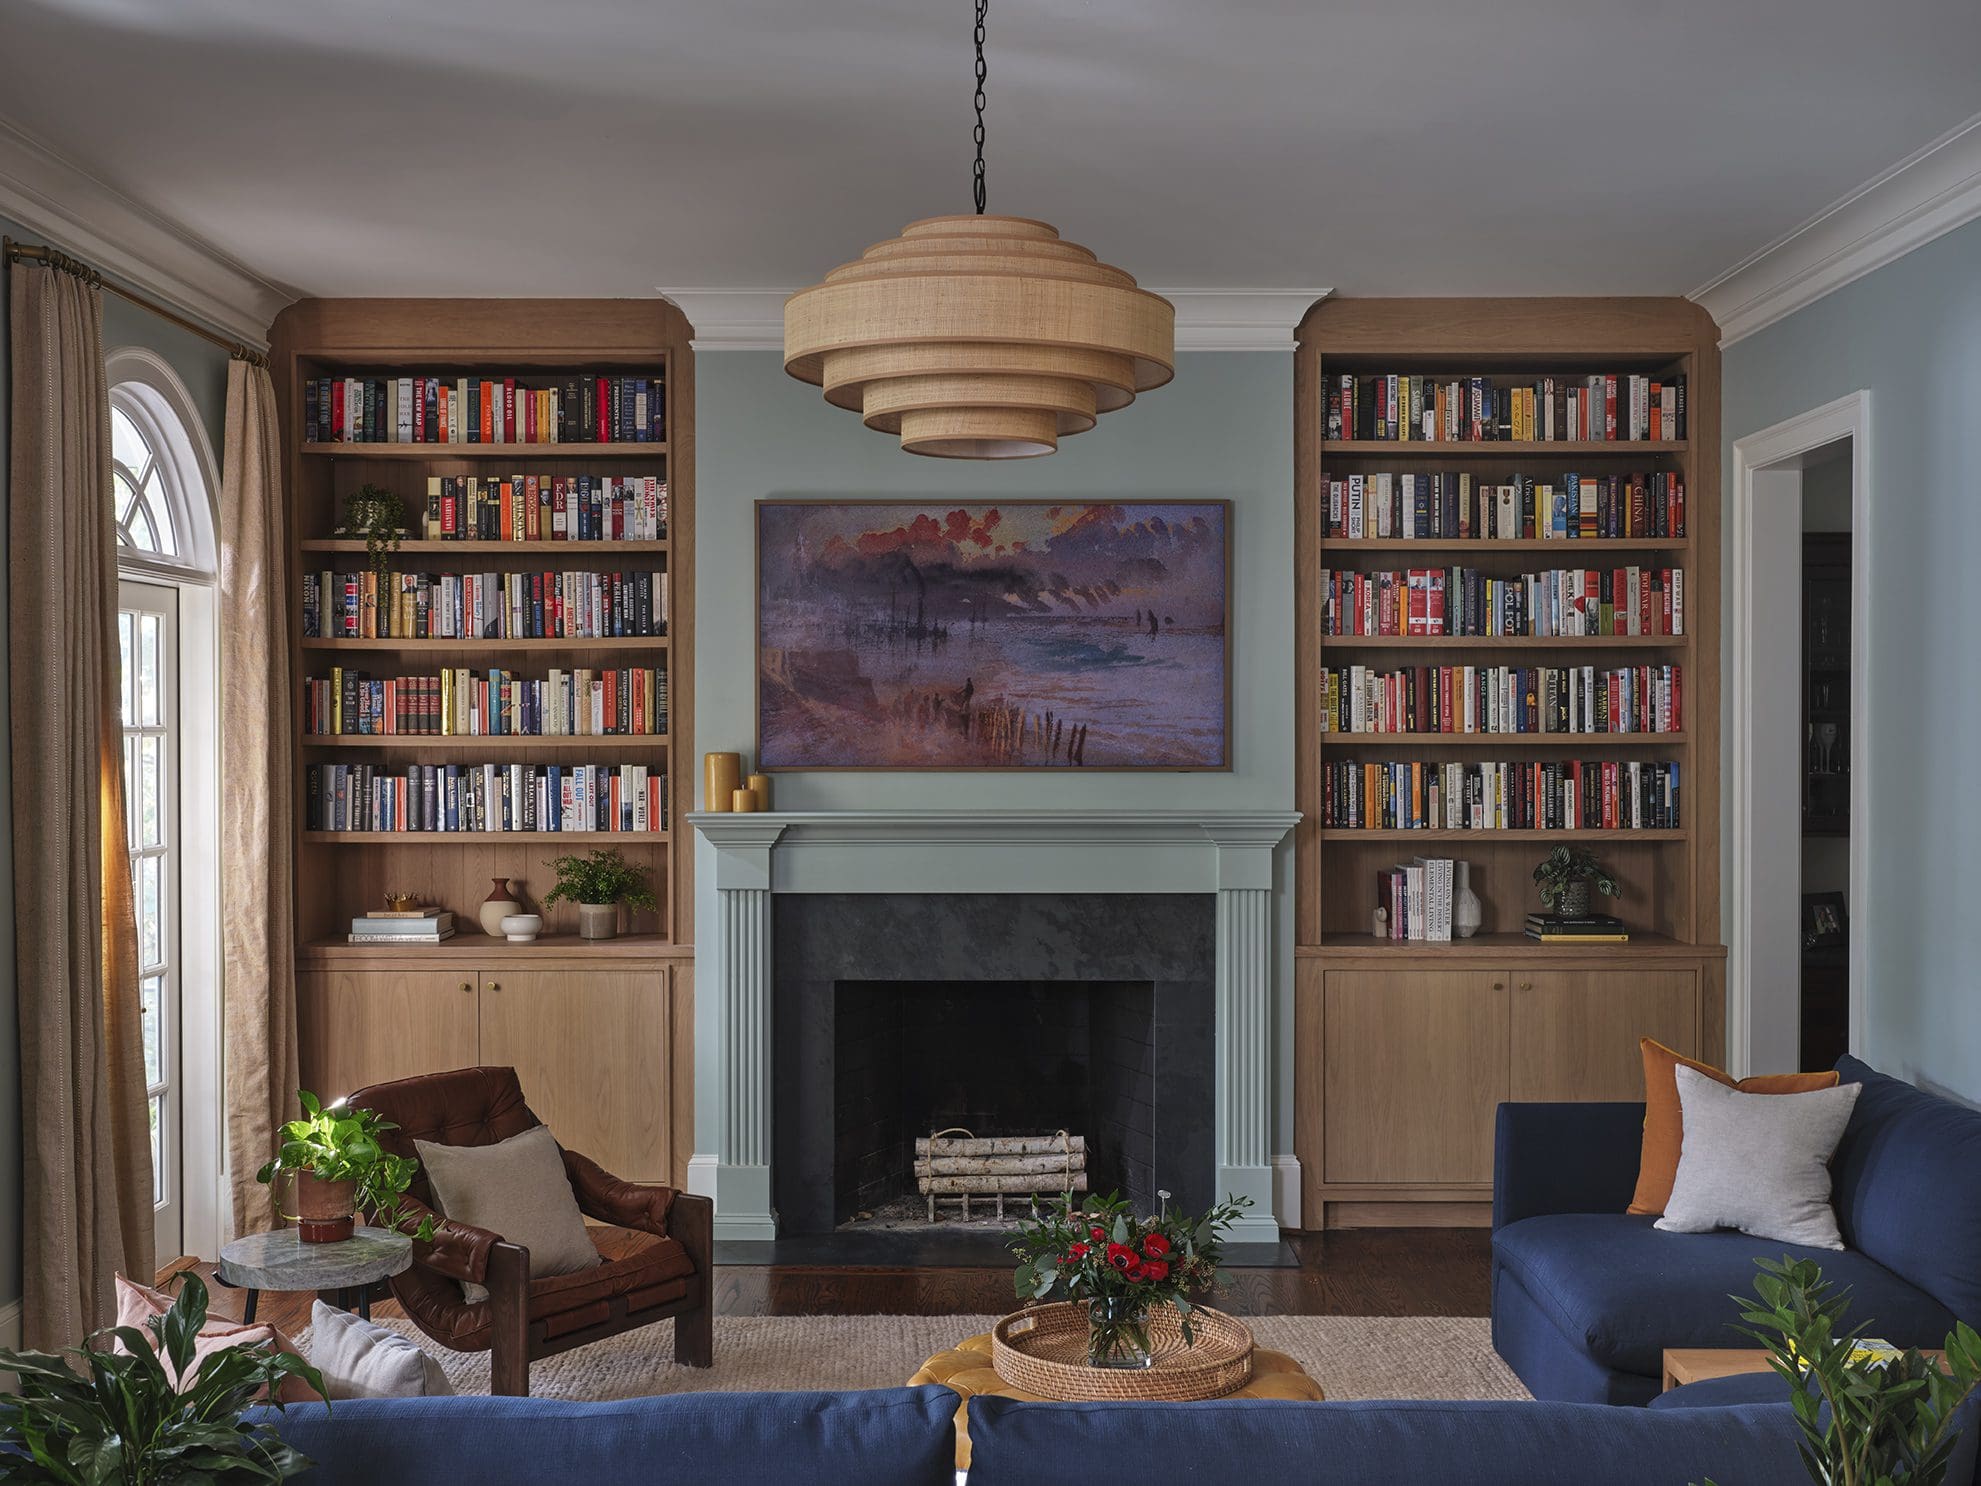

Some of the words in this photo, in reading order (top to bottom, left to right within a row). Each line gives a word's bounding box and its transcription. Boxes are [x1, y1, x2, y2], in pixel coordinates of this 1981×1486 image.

[1343, 390, 1351, 410] ALONE
[556, 484, 564, 510] FDR
[1351, 478, 1361, 510] PUTIN
[1524, 478, 1534, 503] Africa
[1571, 476, 1579, 514] PAKISTAN
[1634, 486, 1644, 522] CHINA
[1504, 588, 1514, 609] POL
[1504, 612, 1514, 633] POT
[1549, 680, 1558, 706] TITAN
[575, 769, 584, 785] FALL
[575, 787, 584, 801] OUT
[1445, 888, 1452, 900] ON
